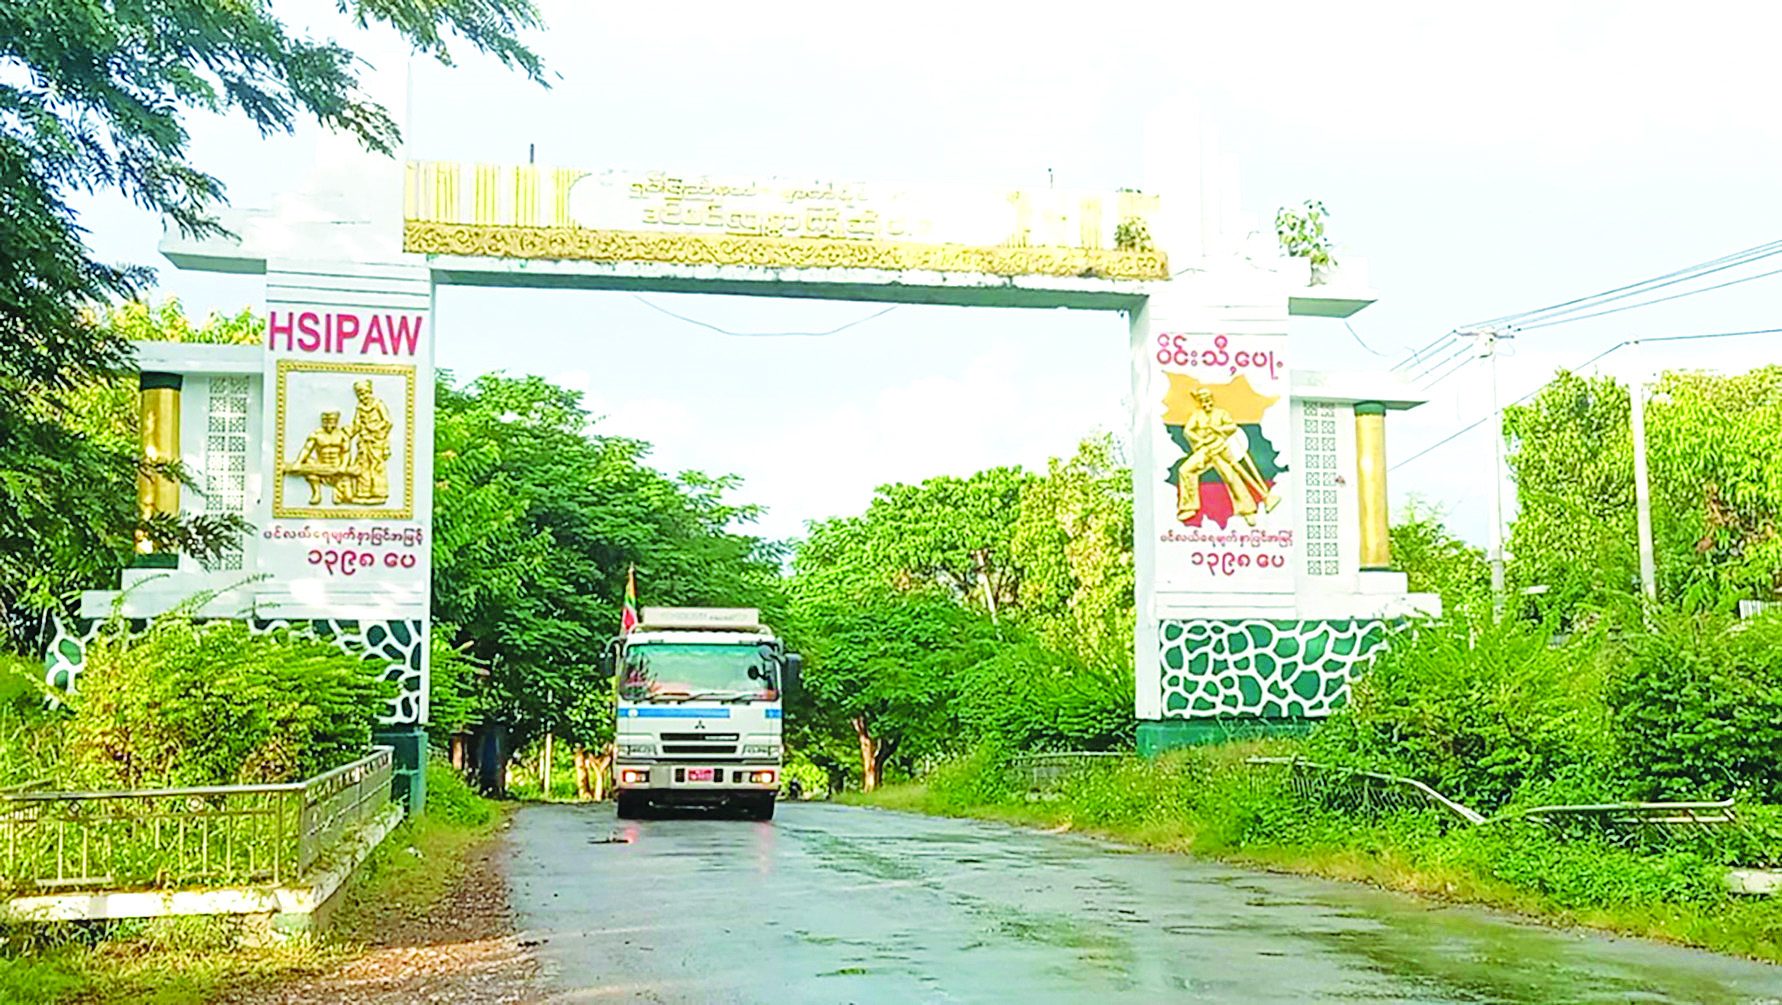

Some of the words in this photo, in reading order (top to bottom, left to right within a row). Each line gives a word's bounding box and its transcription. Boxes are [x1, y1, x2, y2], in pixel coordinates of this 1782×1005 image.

[269, 311, 422, 356] HSIPAW
[384, 552, 416, 568] ပေ
[1256, 554, 1285, 568] ပေ
